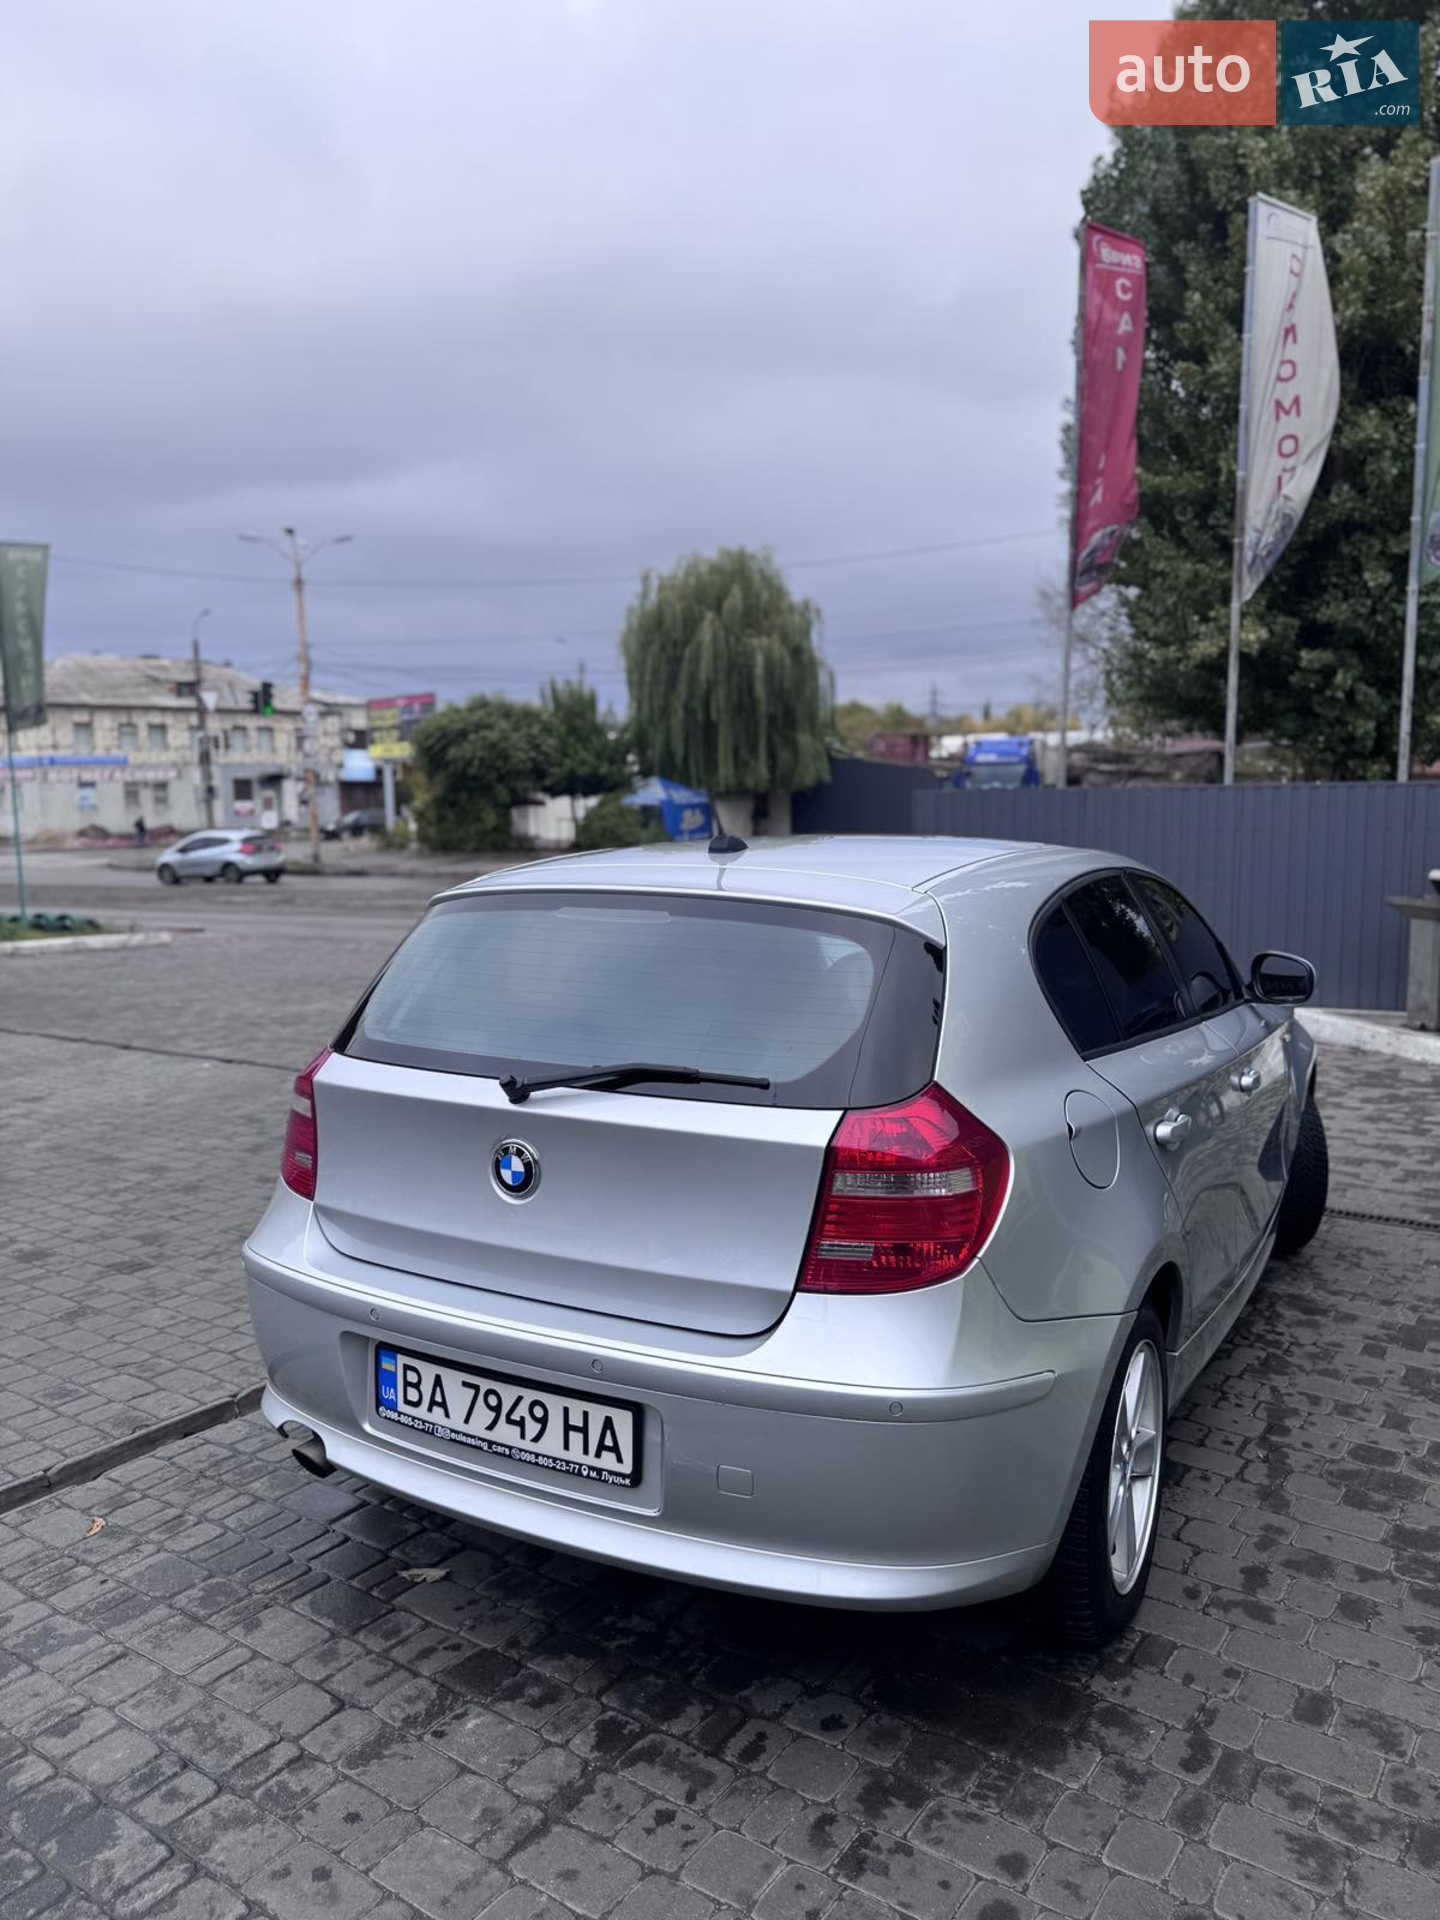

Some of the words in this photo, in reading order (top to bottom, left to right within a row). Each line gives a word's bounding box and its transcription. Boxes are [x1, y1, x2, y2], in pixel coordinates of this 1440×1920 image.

[381, 1385, 397, 1402] UA
[402, 1362, 451, 1419] BA
[461, 1380, 549, 1444] 7949
[562, 1405, 624, 1464] HA
[520, 1451, 580, 1474] 098-805-23-77
[601, 1471, 632, 1487] Луцьк
